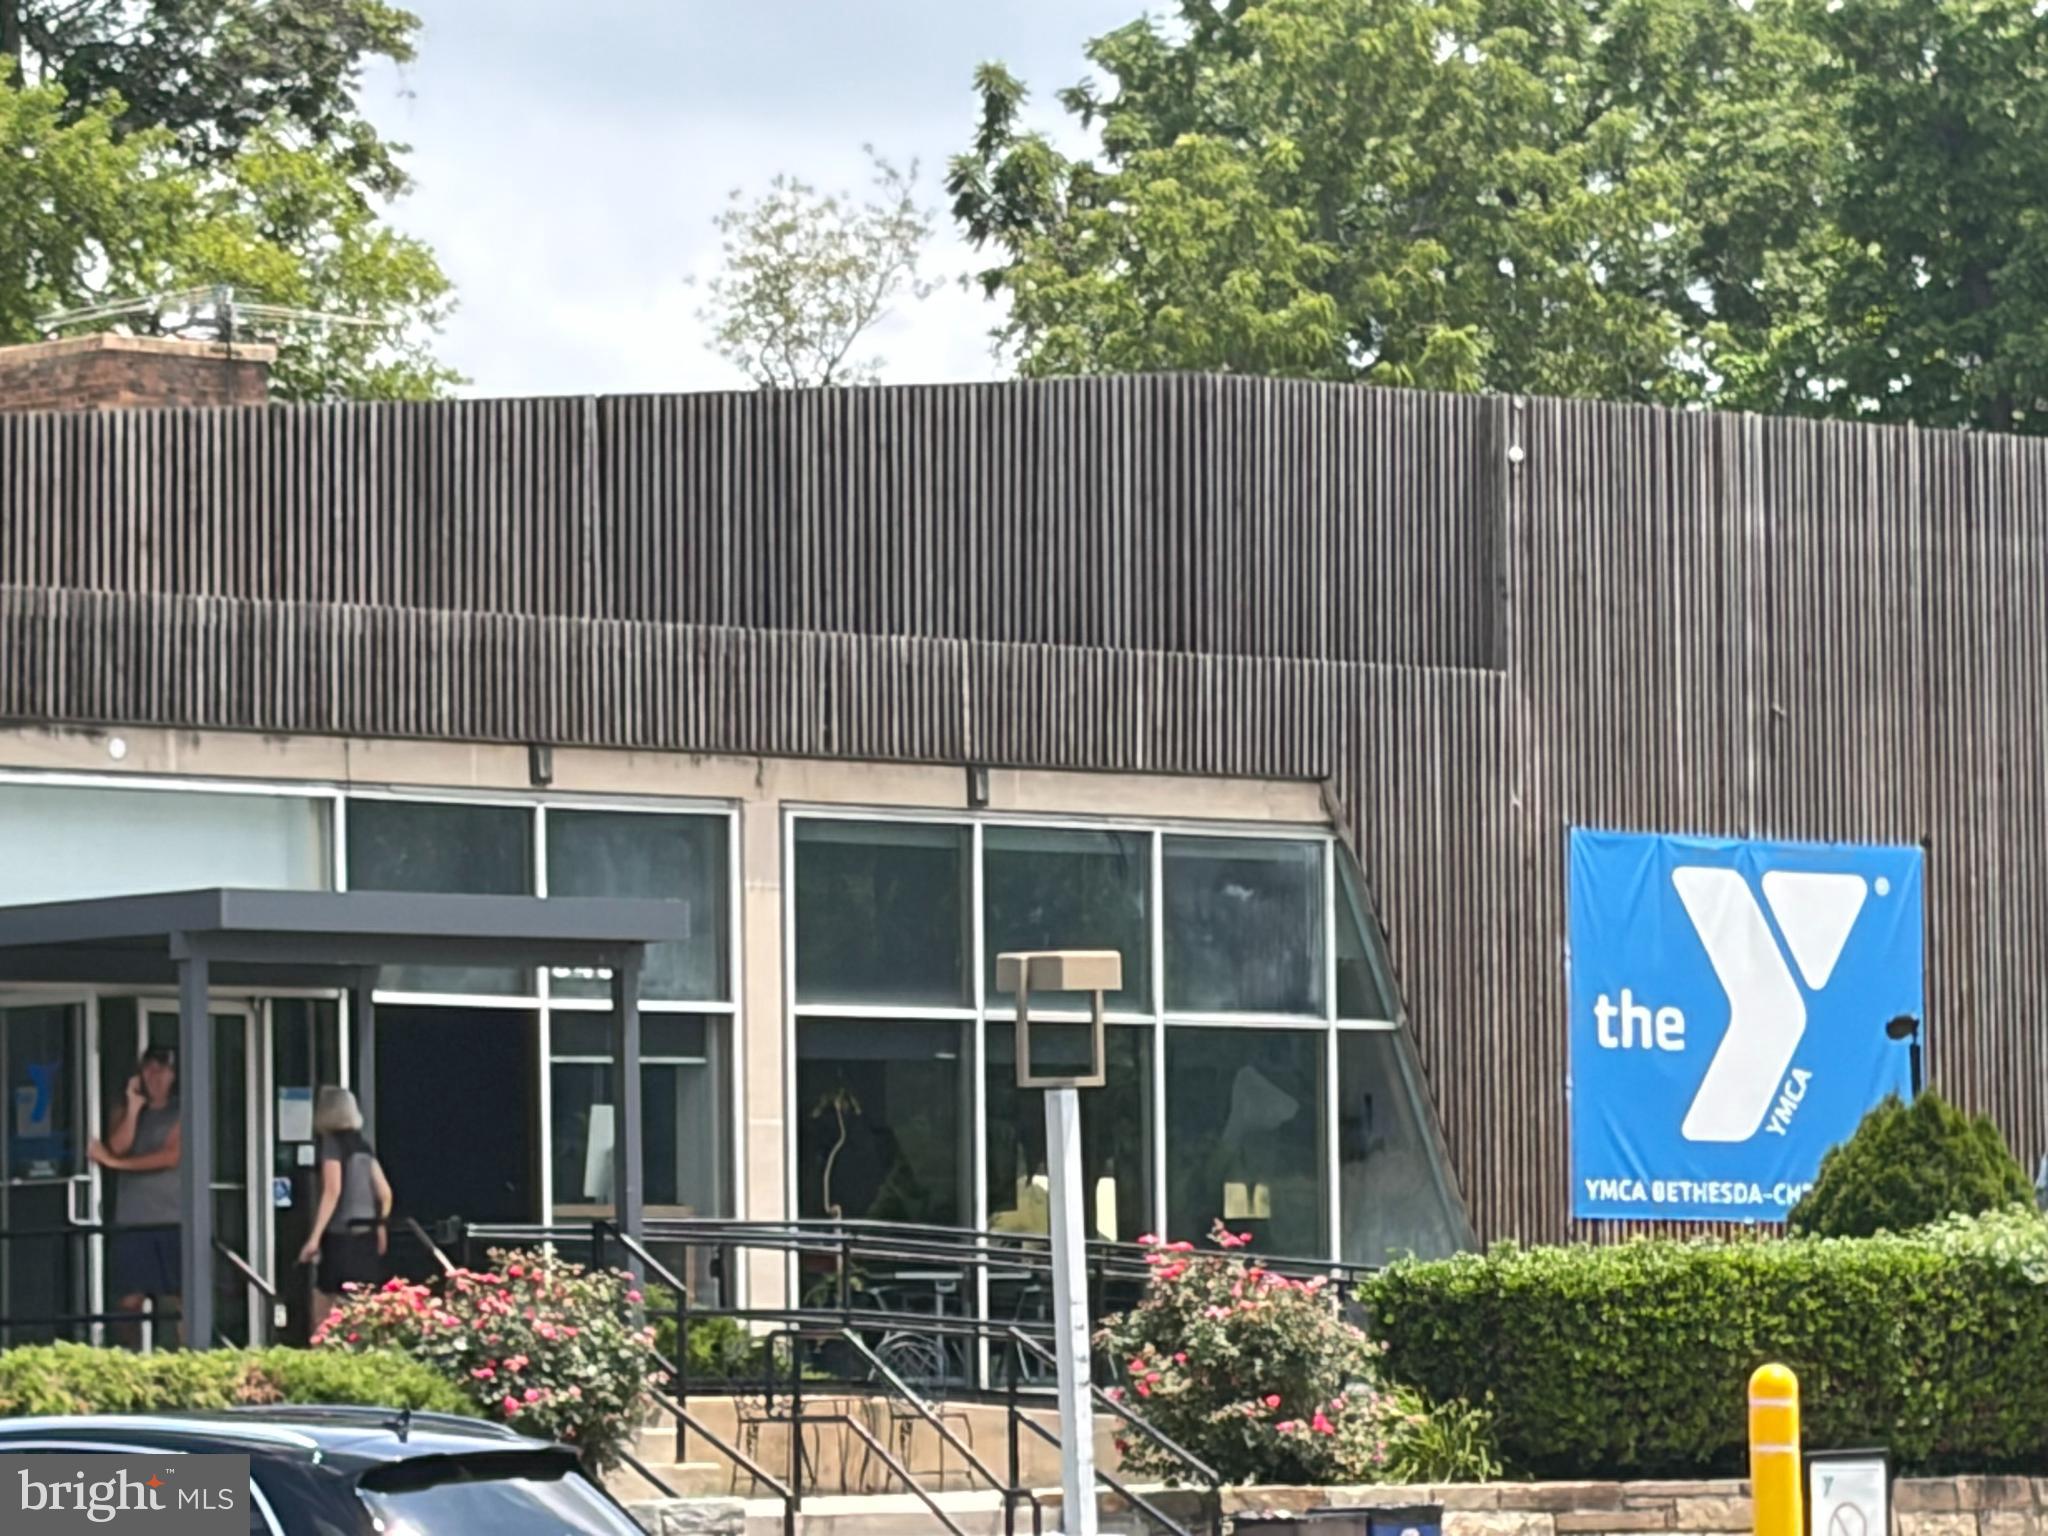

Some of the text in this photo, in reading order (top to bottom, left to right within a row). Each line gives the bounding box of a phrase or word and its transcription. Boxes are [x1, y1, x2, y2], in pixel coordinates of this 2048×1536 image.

[1593, 987, 1686, 1052] the
[1765, 1067, 1813, 1137] YMCA
[1584, 1178, 1814, 1206] YMCA BETHESDA-CH
